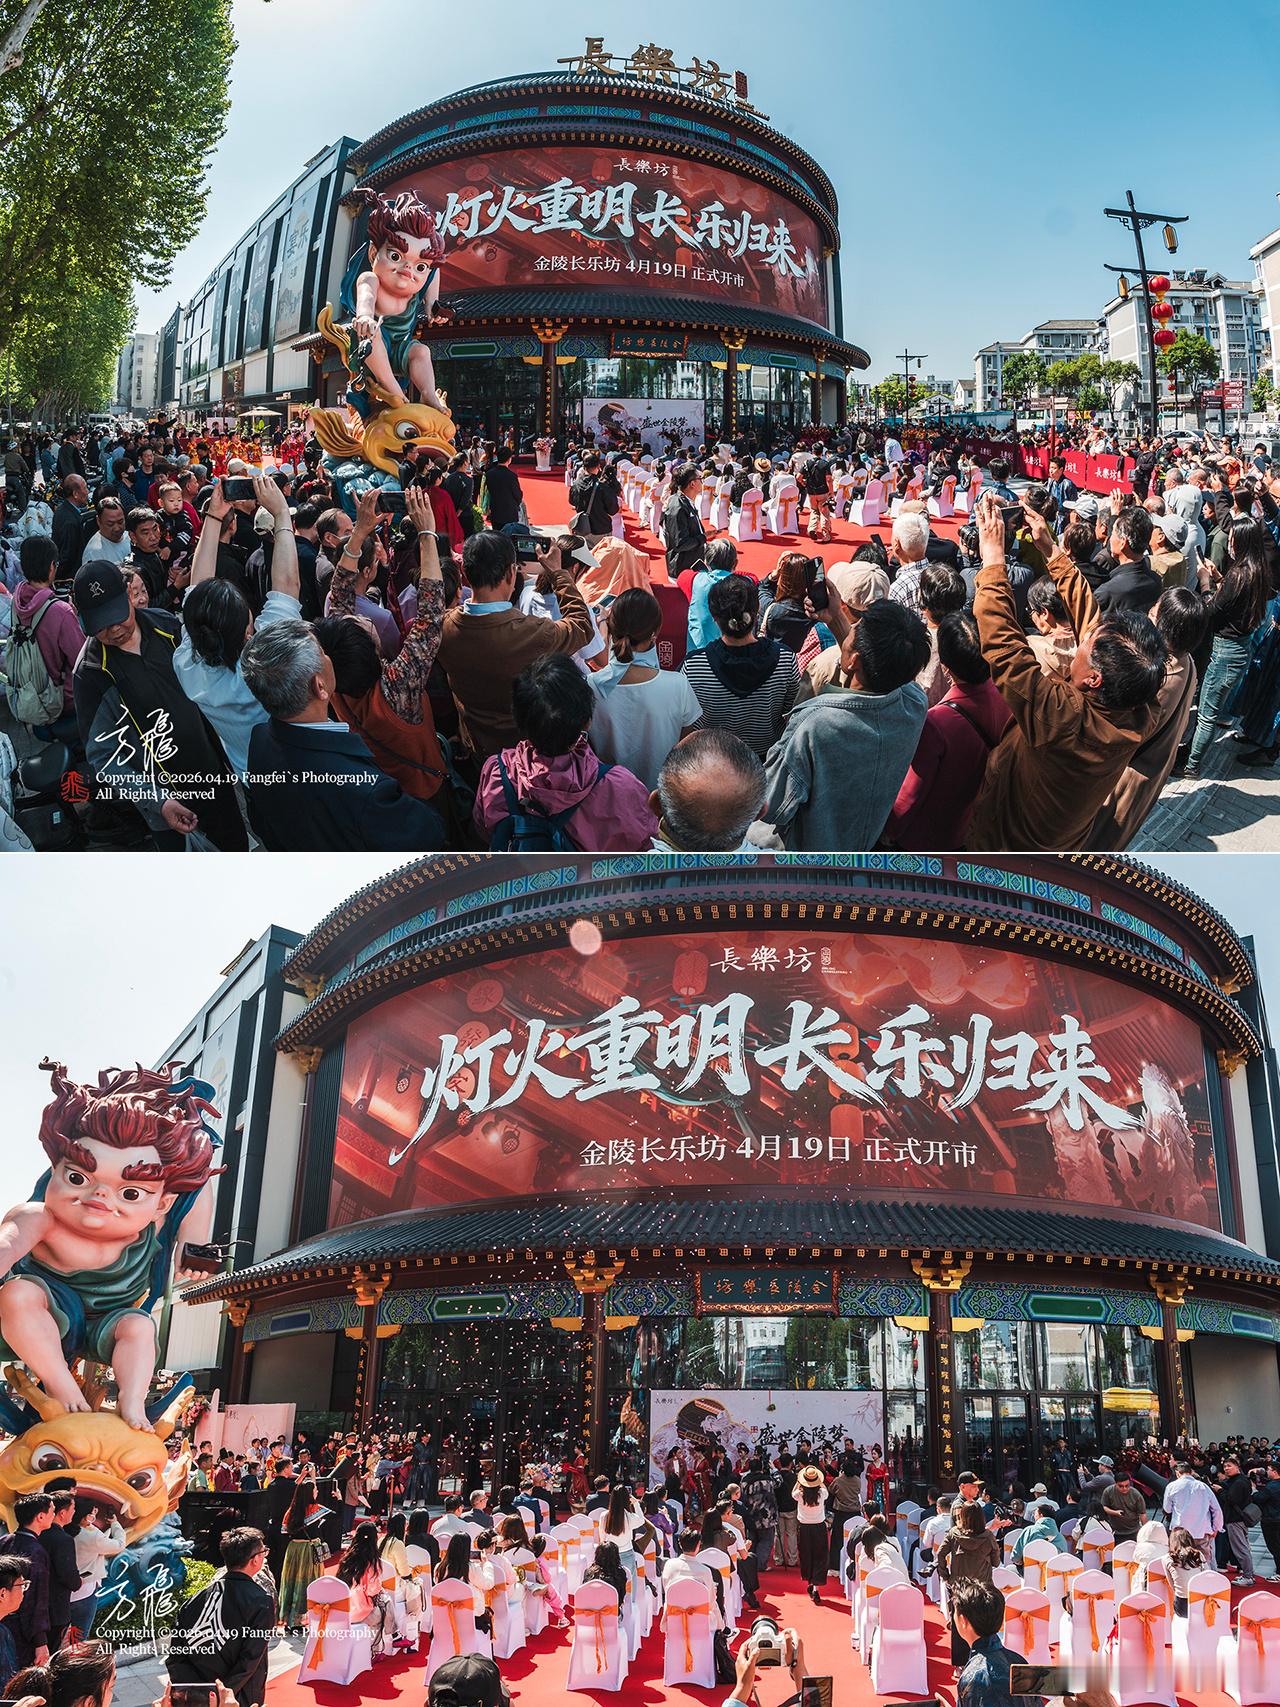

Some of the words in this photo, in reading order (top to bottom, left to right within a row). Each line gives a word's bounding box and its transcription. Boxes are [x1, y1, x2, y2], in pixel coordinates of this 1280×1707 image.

[557, 37, 732, 99] 長樂坊
[613, 157, 670, 176] 長樂坊
[435, 176, 806, 278] 灯火重明长乐归来
[533, 254, 622, 273] 金陵长乐坊
[625, 257, 687, 278] 4月19日
[691, 265, 746, 288] 正式开市
[710, 945, 816, 973] 長樂坊
[388, 992, 1148, 1166] 灯火重明长乐归来
[578, 1135, 728, 1168] 金陵长乐坊
[735, 1134, 852, 1162] 4月19日
[863, 1137, 978, 1169] 正式开市
[756, 1422, 849, 1446] 盛世金陵梦
